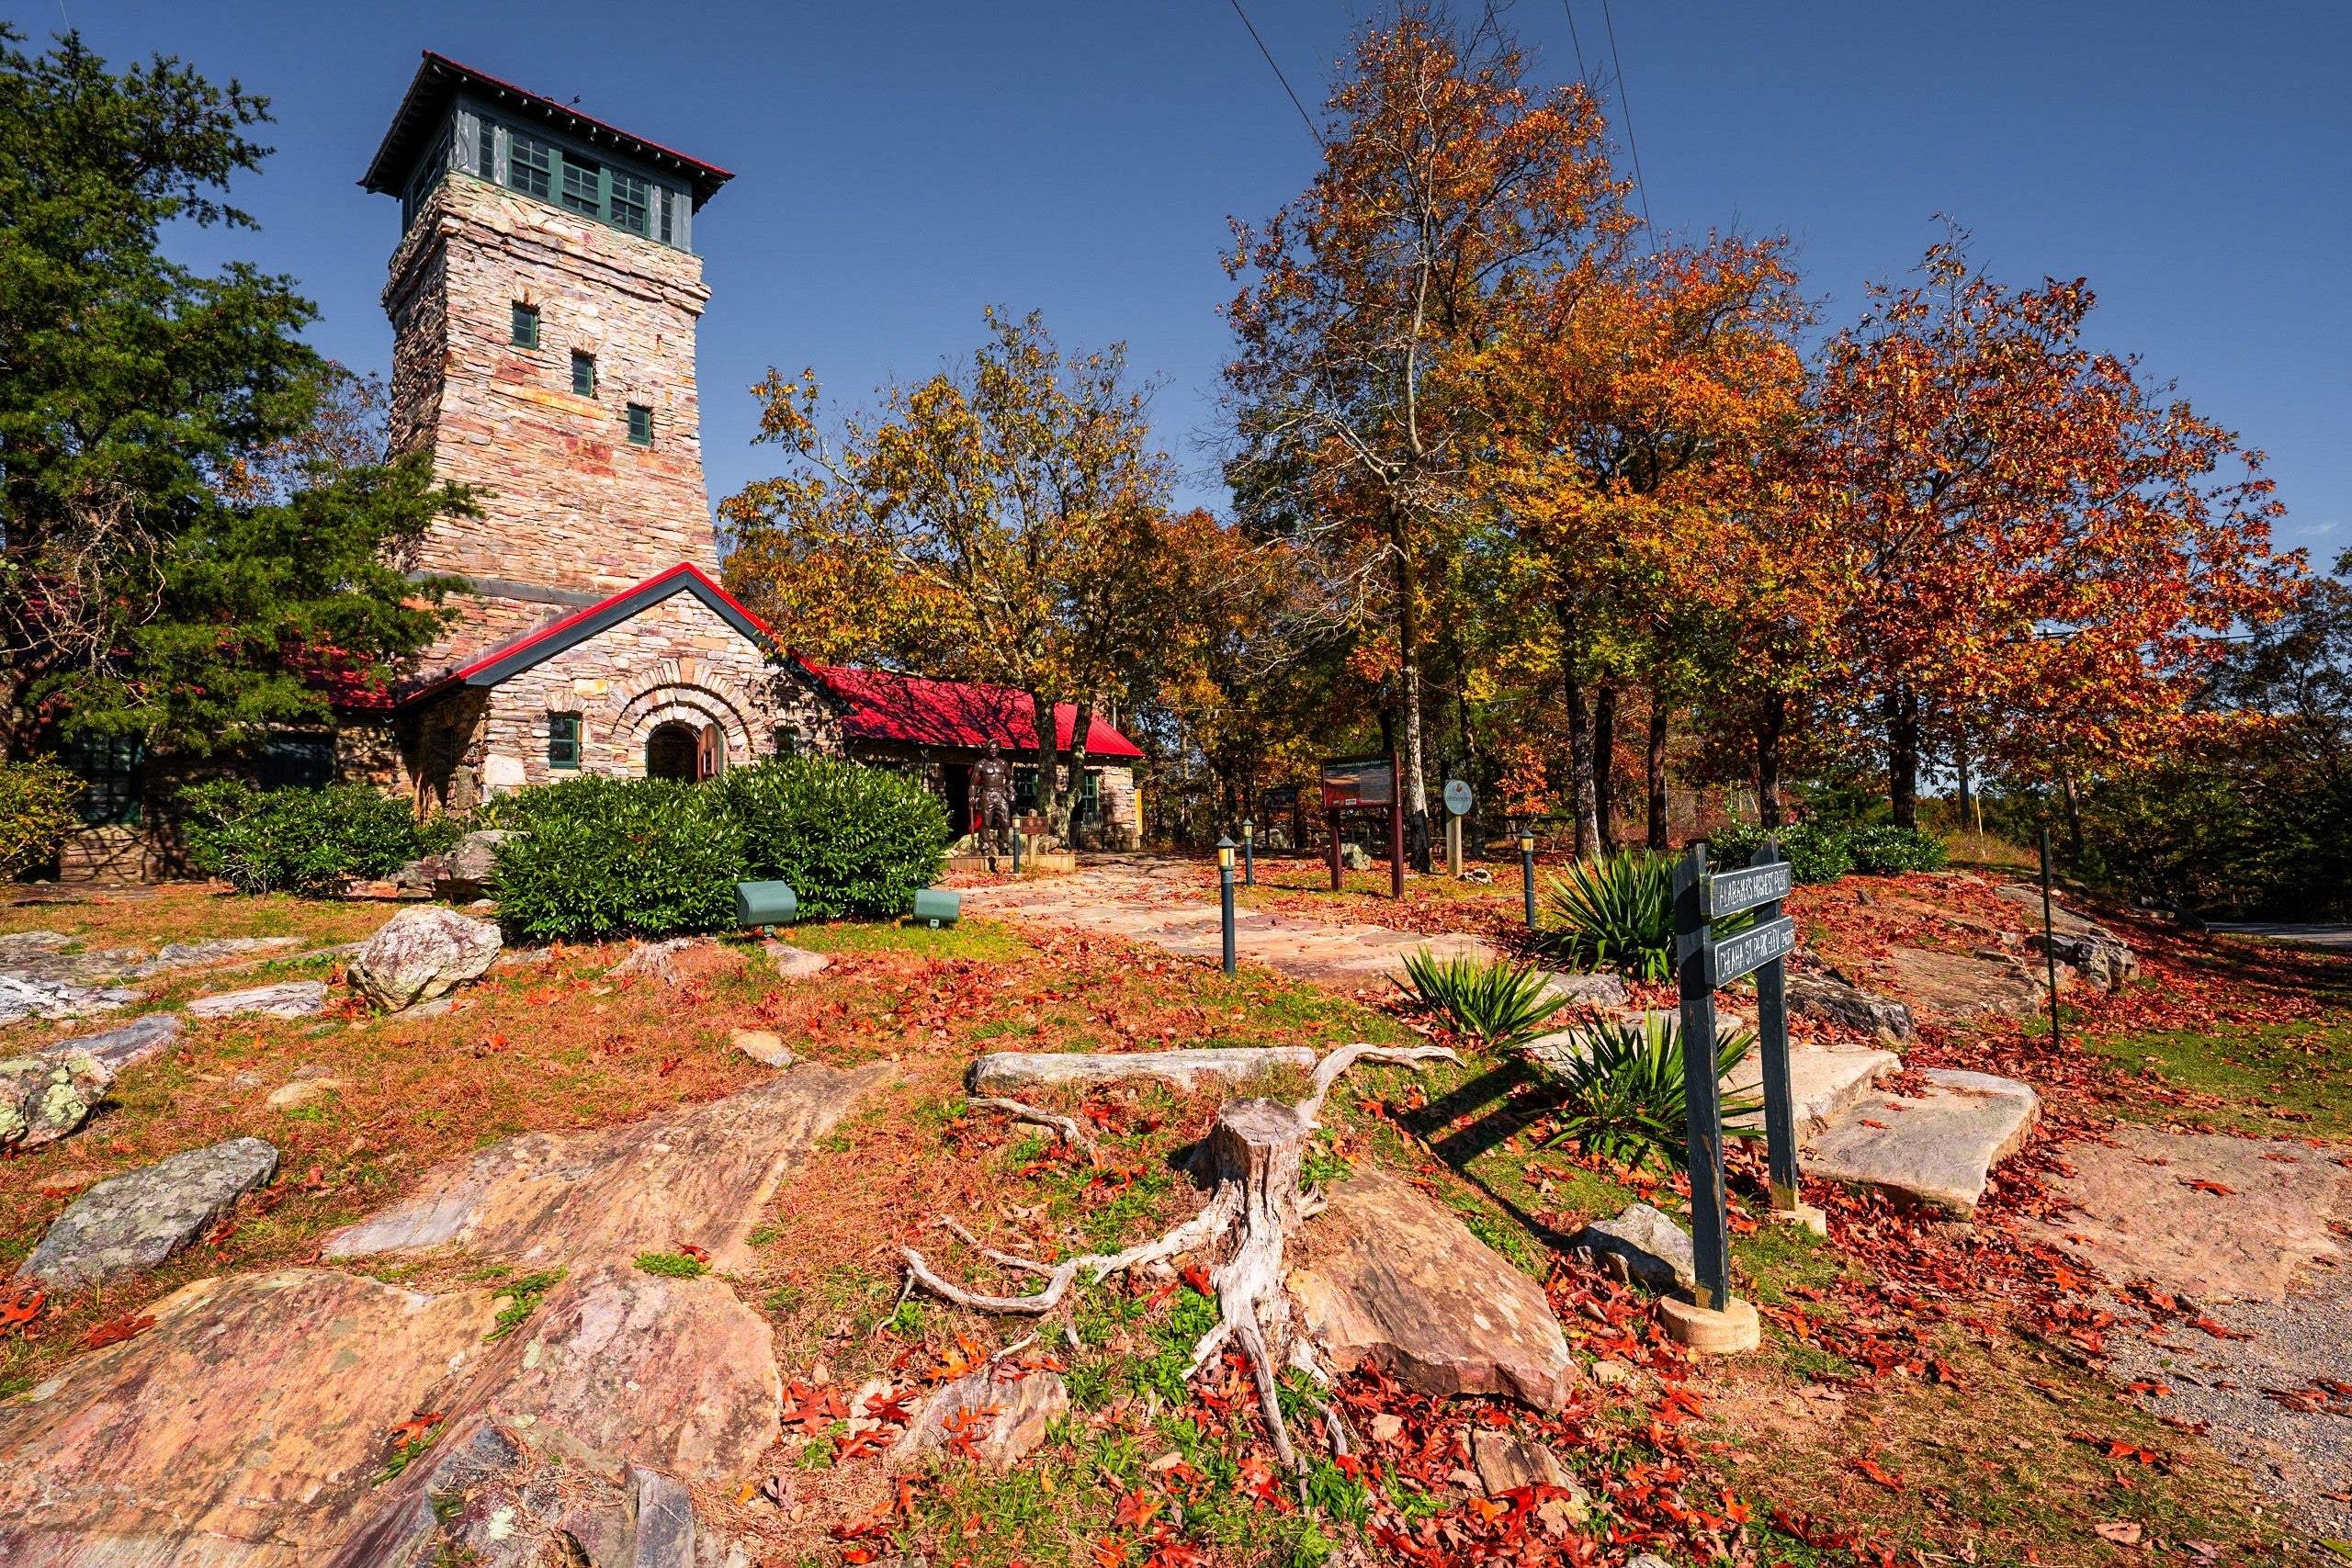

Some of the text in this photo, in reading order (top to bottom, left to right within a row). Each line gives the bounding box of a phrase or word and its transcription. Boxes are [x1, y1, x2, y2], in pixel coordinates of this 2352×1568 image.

[1719, 869, 1788, 908] ALABAMA'S HIGHEST POINT
[1720, 943, 1744, 977] CHEAHA
